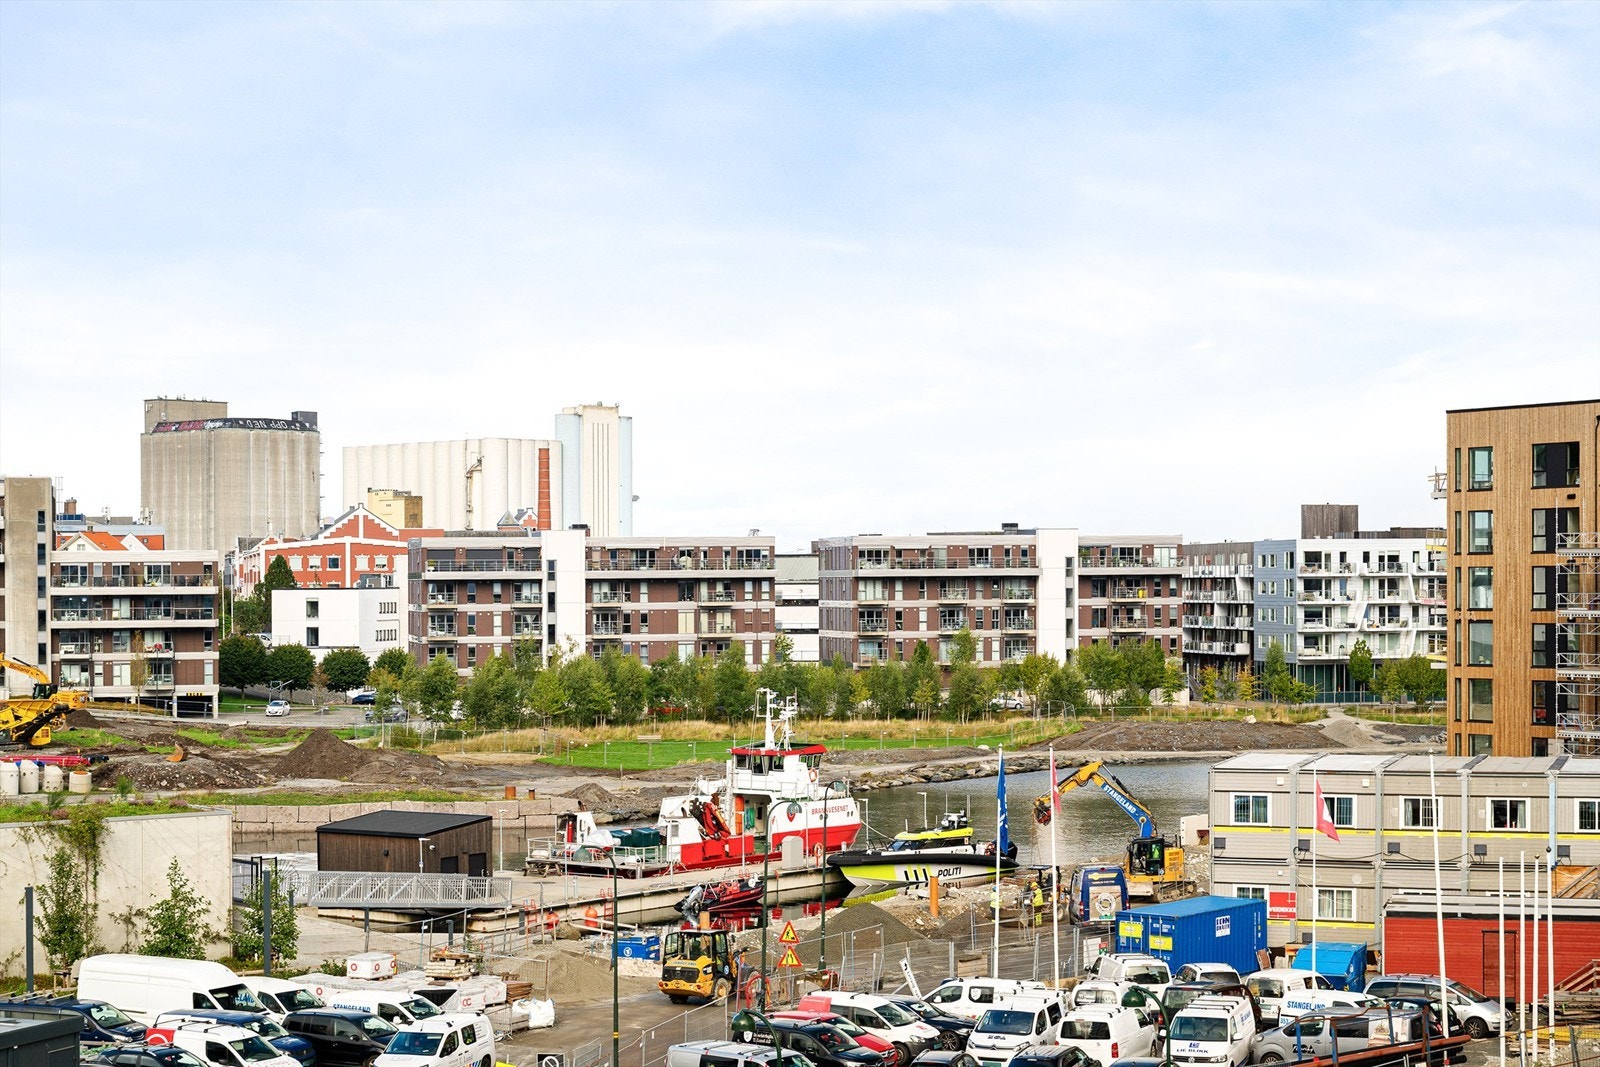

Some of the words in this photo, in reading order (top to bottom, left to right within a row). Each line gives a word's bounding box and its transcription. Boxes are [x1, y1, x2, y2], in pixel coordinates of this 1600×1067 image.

[246, 419, 267, 429] NED
[268, 420, 288, 429] OPP
[1103, 784, 1137, 814] STANGELAND
[937, 867, 962, 877] POLITI
[333, 1003, 371, 1013] STANGELAND
